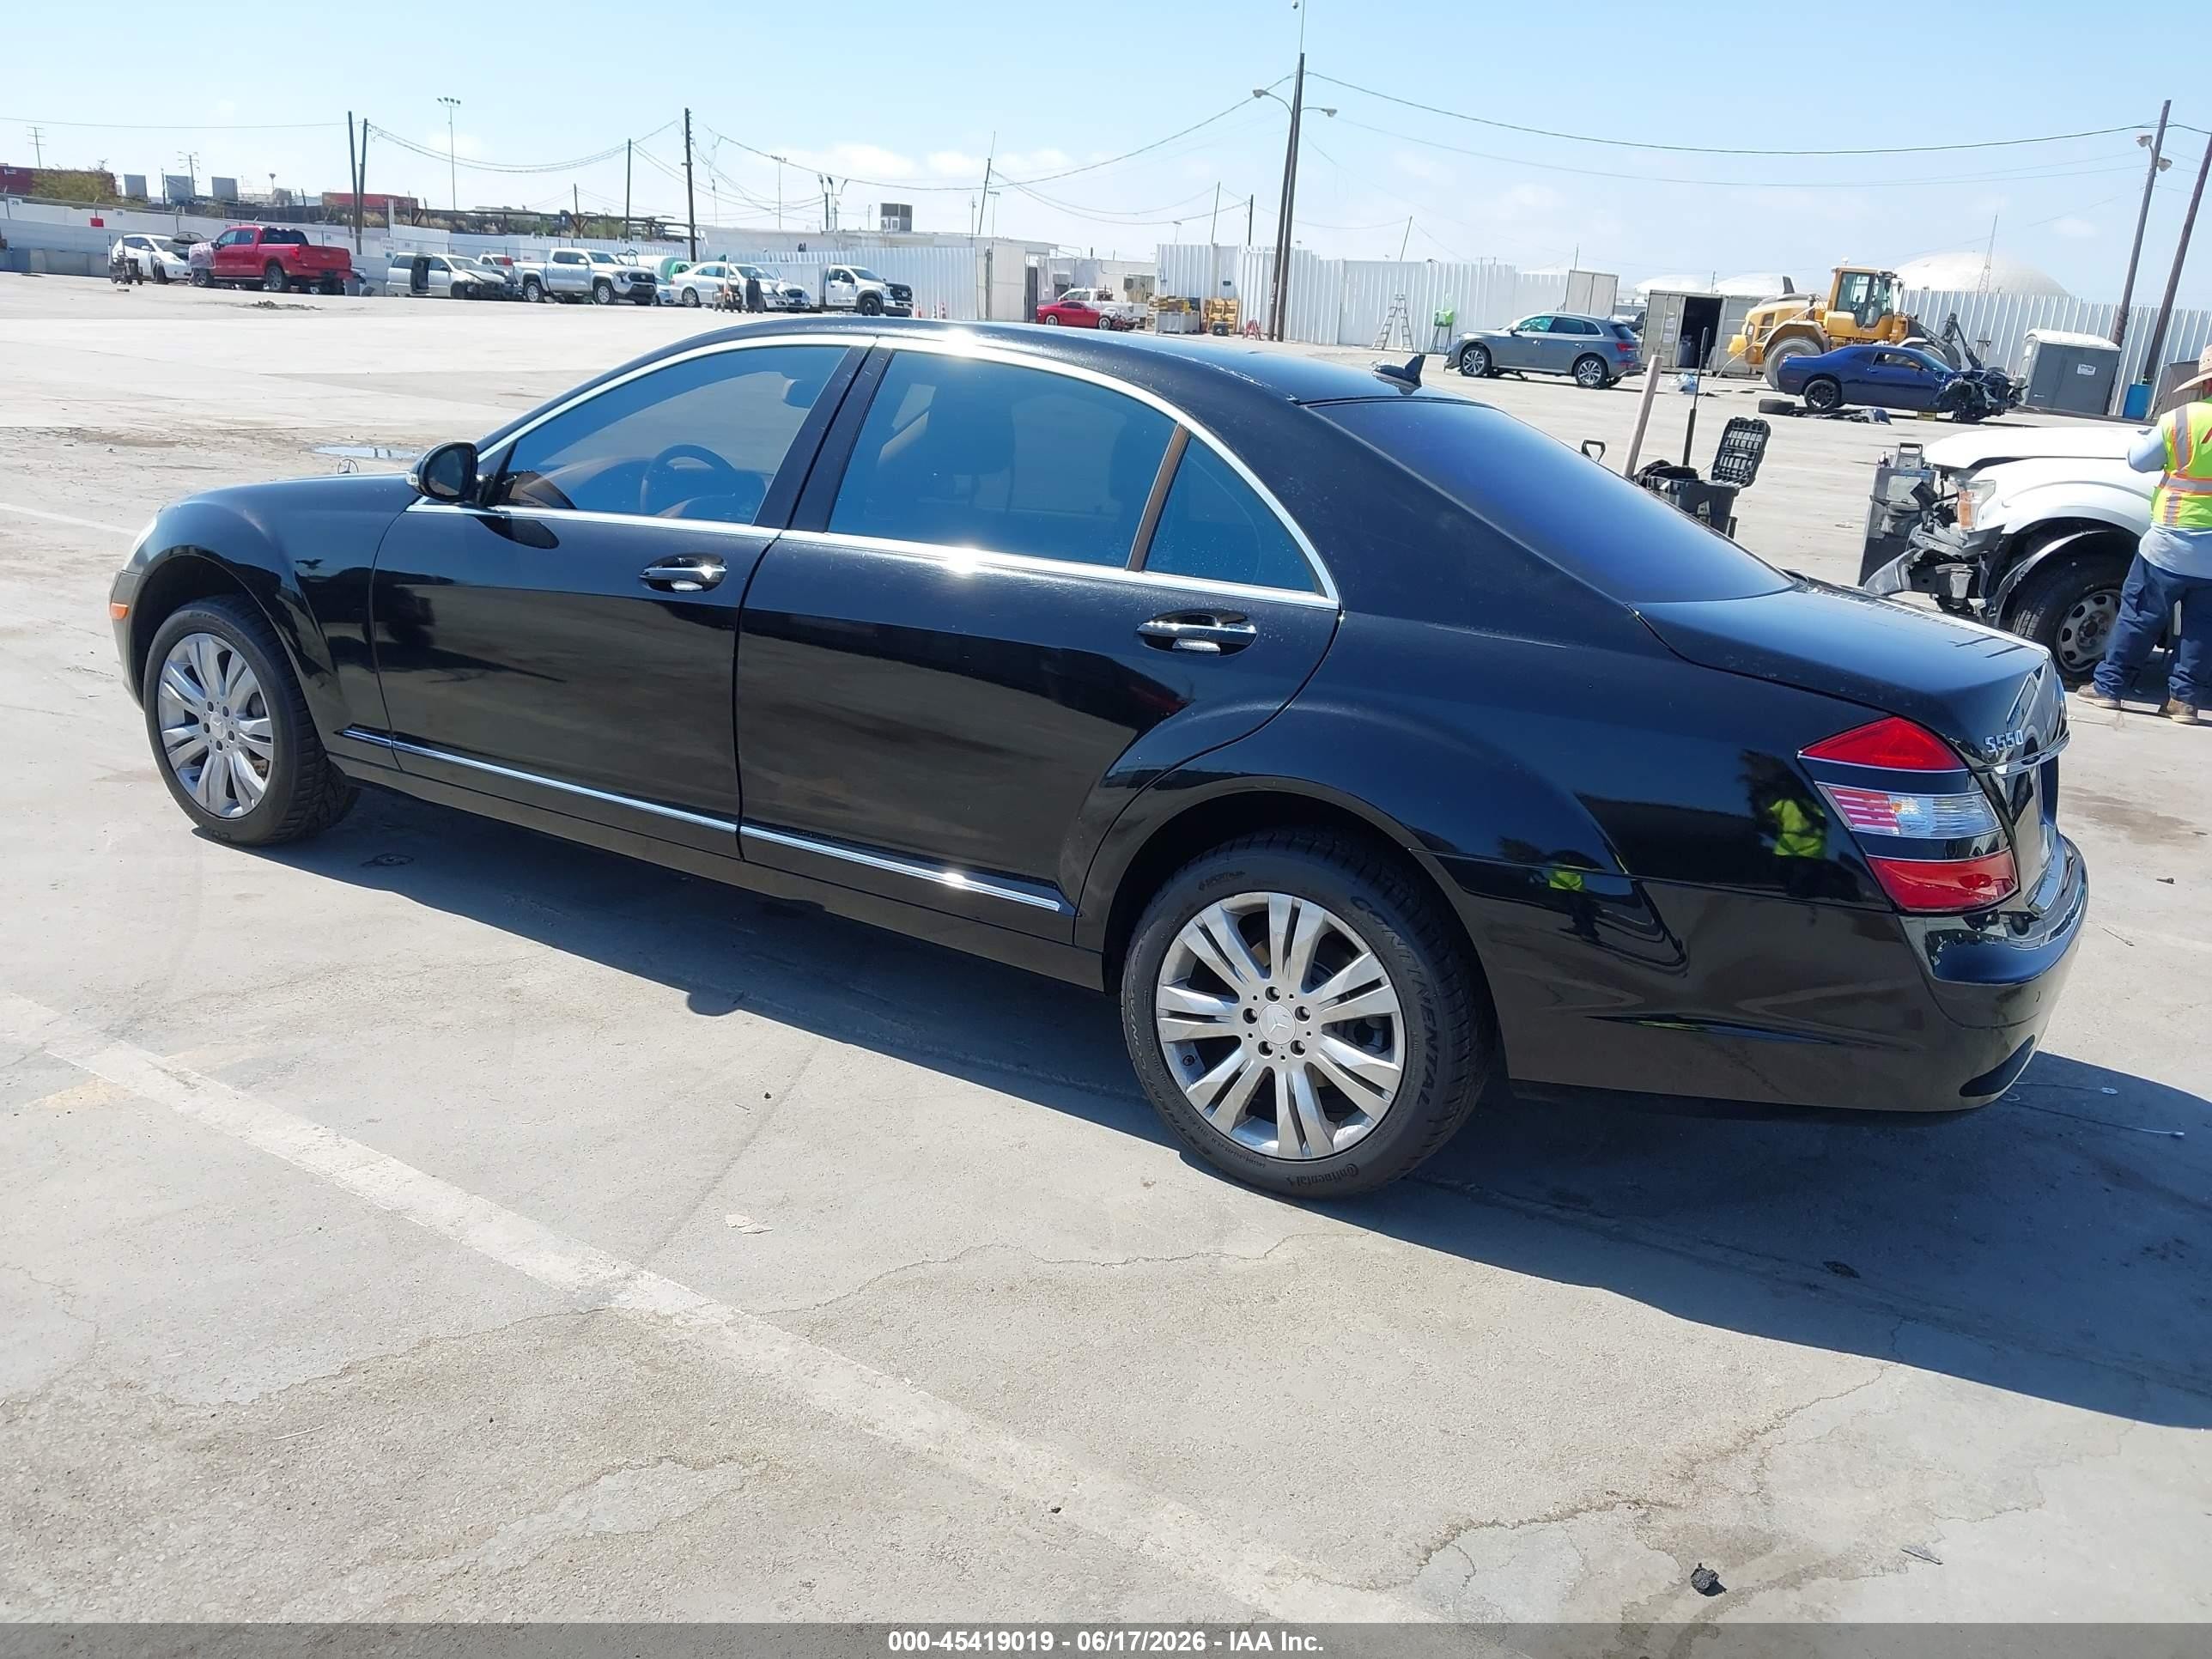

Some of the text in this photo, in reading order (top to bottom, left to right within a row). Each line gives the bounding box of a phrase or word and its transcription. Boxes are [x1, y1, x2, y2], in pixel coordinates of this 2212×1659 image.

[1984, 729, 2024, 753] S550
[1350, 896, 1439, 1106] CONTINENTAL
[1295, 1162, 1360, 1187] Continental
